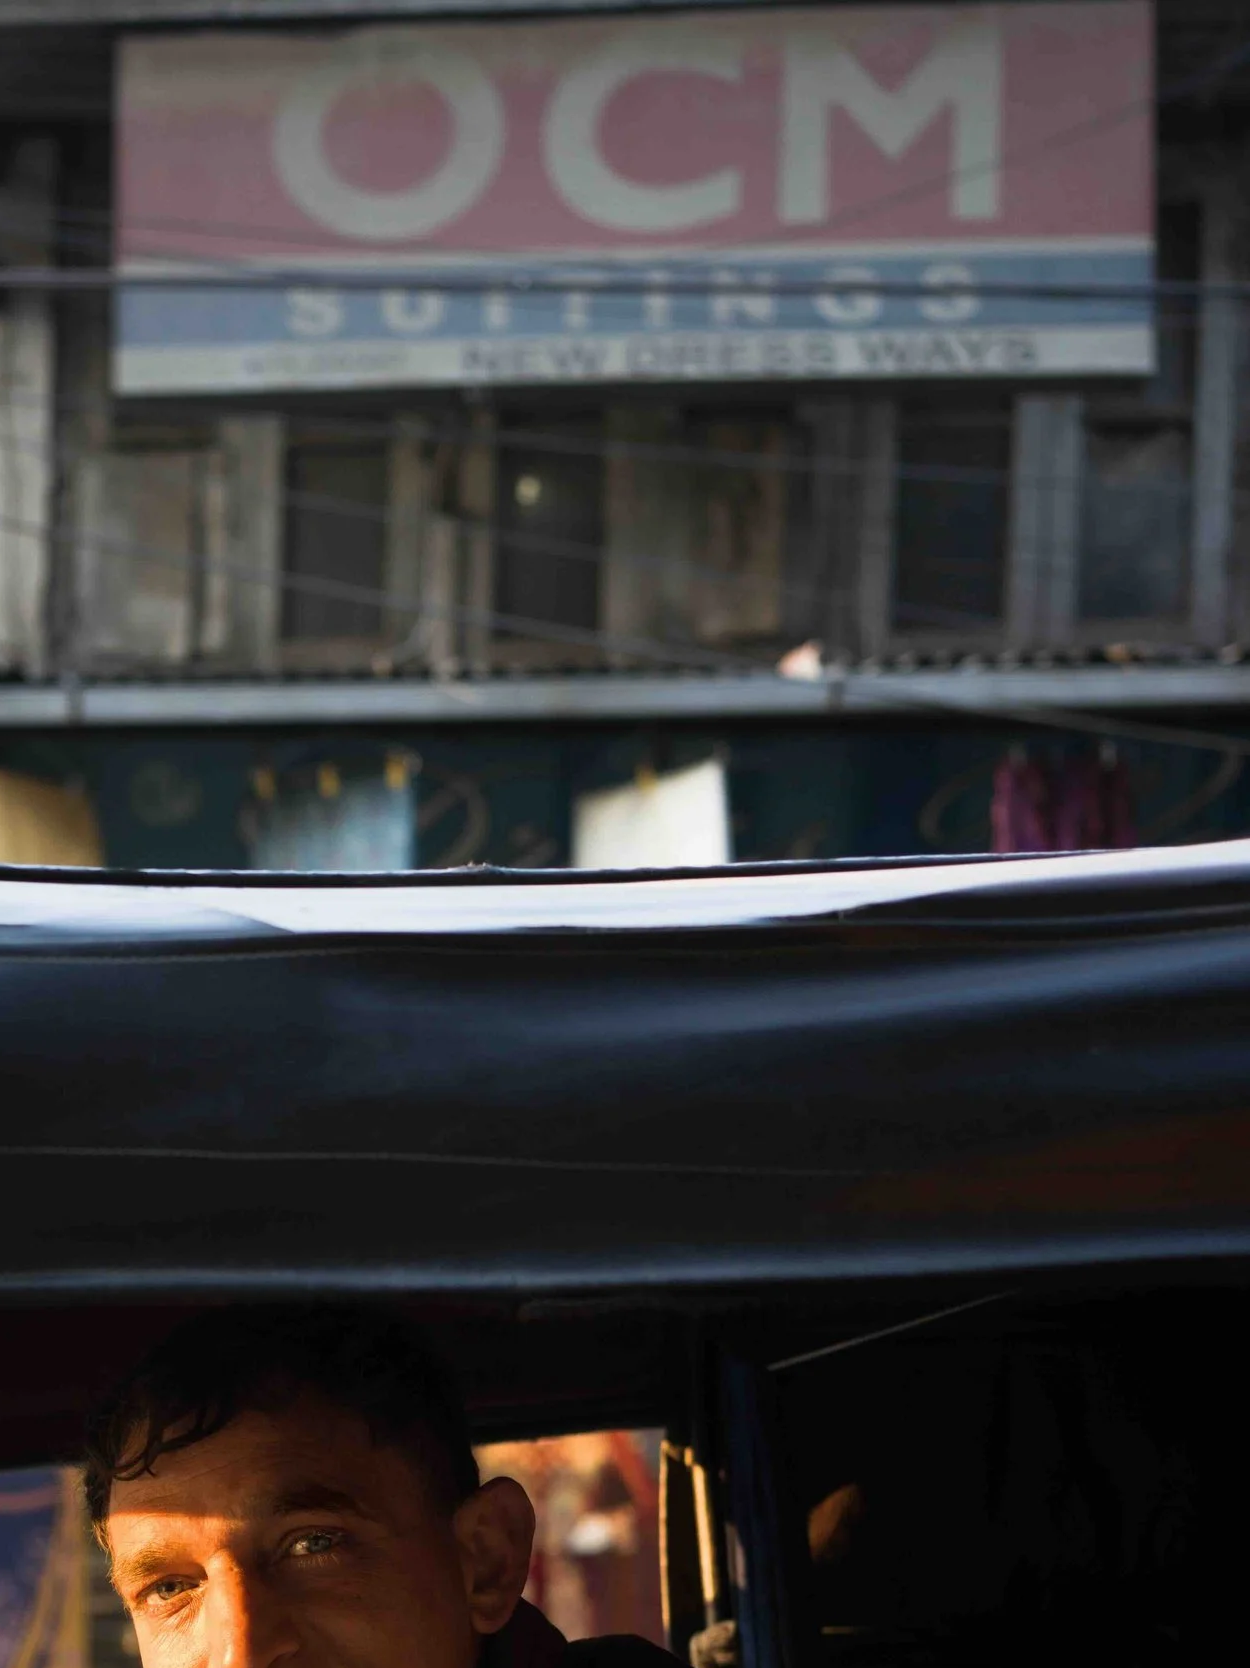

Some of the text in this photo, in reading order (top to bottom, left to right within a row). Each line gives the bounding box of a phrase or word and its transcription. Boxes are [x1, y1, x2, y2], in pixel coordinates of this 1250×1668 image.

[273, 22, 1000, 241] OCM
[284, 263, 982, 336] SUITINGS
[459, 337, 607, 380] NEW
[624, 331, 838, 379] DRESS
[857, 328, 1042, 374] WAYS
